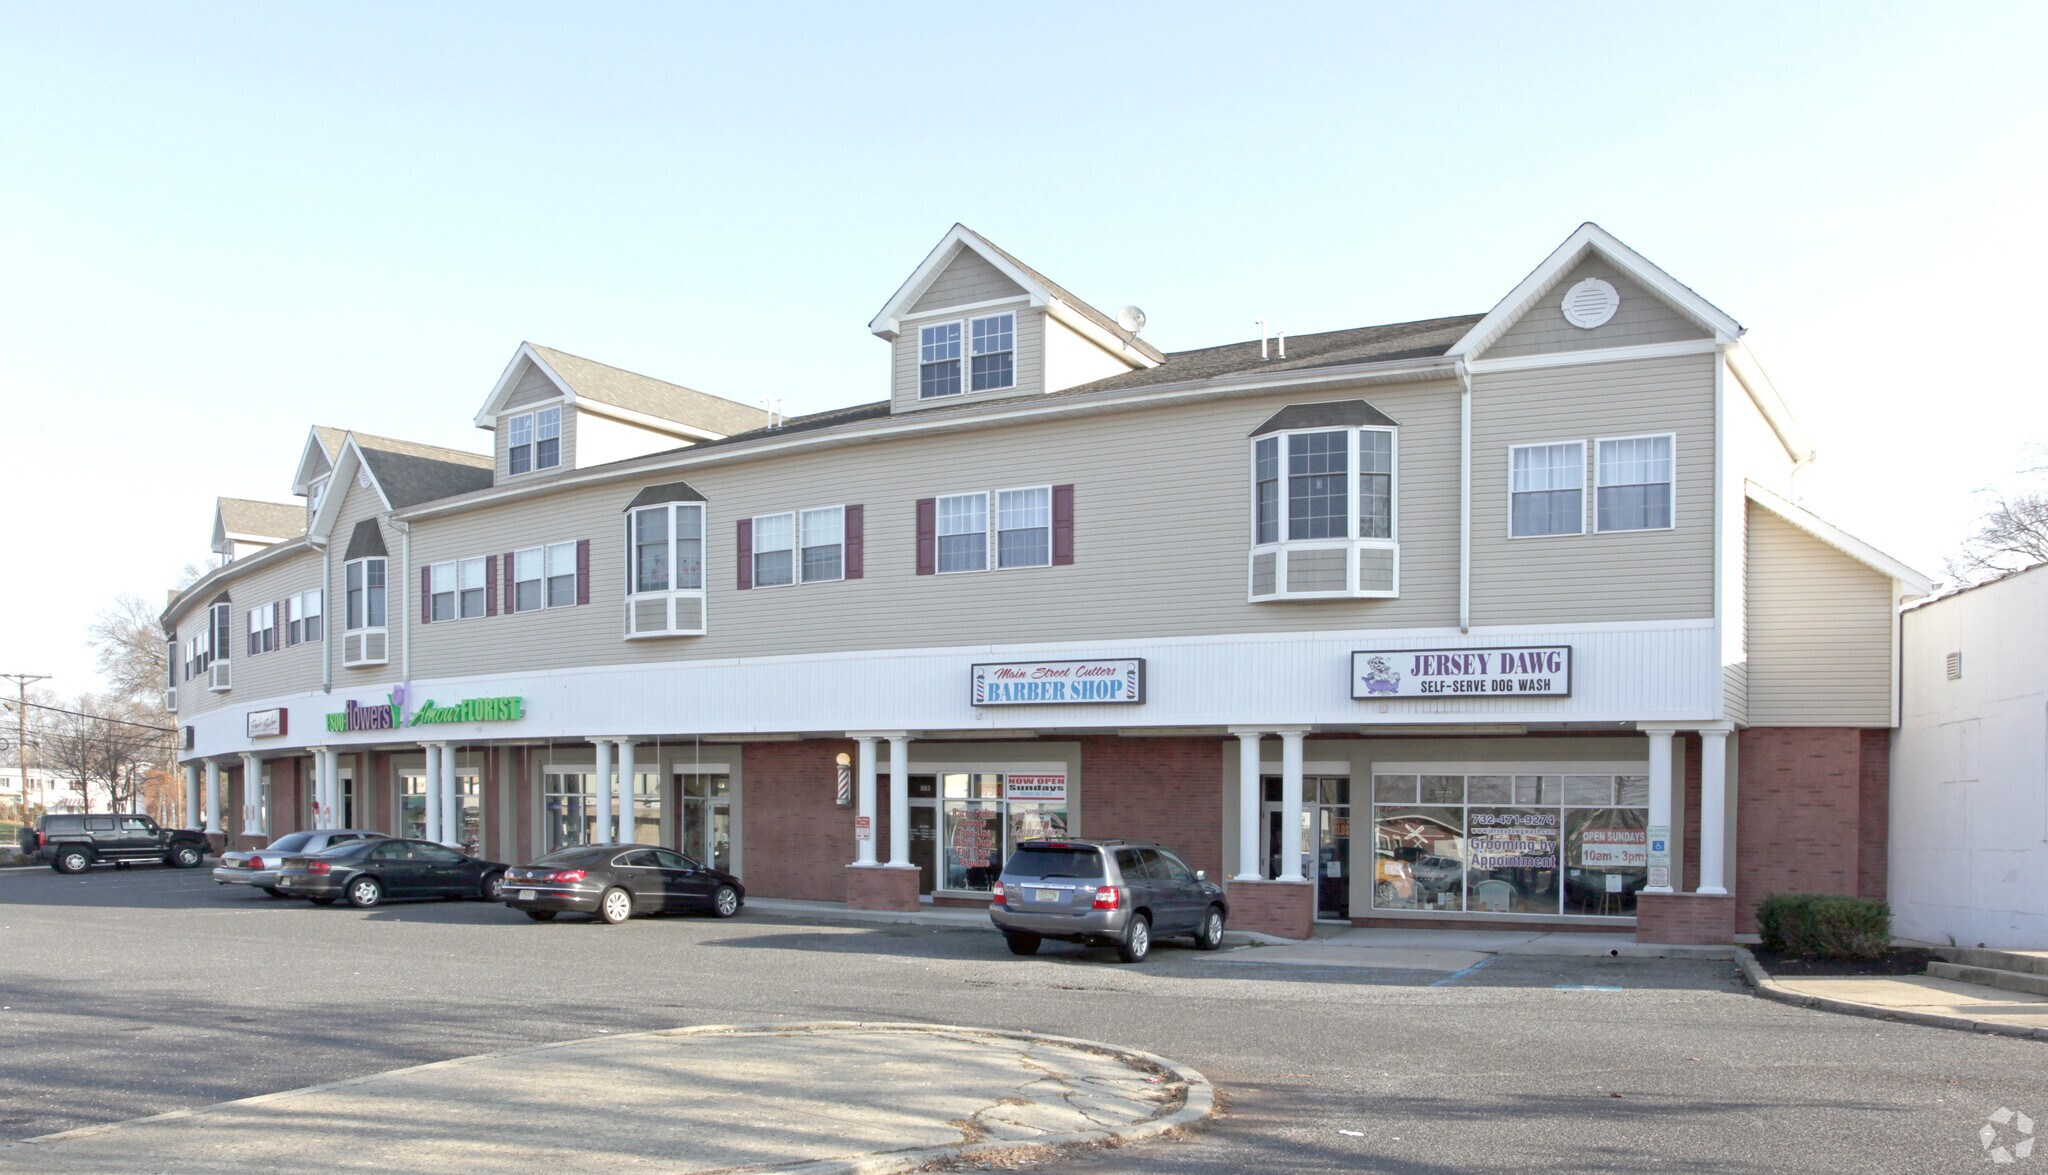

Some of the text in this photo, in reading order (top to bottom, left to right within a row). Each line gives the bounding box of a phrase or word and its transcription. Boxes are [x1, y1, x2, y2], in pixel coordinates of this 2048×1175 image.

[1410, 651, 1562, 677] JERSEY DAWG
[994, 665, 1117, 680] Main Street Cutters
[988, 679, 1123, 702] BARBER SHOP
[1420, 678, 1551, 693] SELF-SERVE DOG WASH
[411, 698, 461, 727] Amour
[461, 697, 522, 721] FLORIST
[1008, 784, 1064, 792] Sundays
[1471, 814, 1556, 825] 732-471-9274
[1582, 831, 1646, 842] OPEN SUNDAYS
[1471, 838, 1556, 854] Grooming by
[1471, 854, 1557, 869] Appointment
[1583, 850, 1612, 861] 10am
[1622, 851, 1645, 864] 3pm
